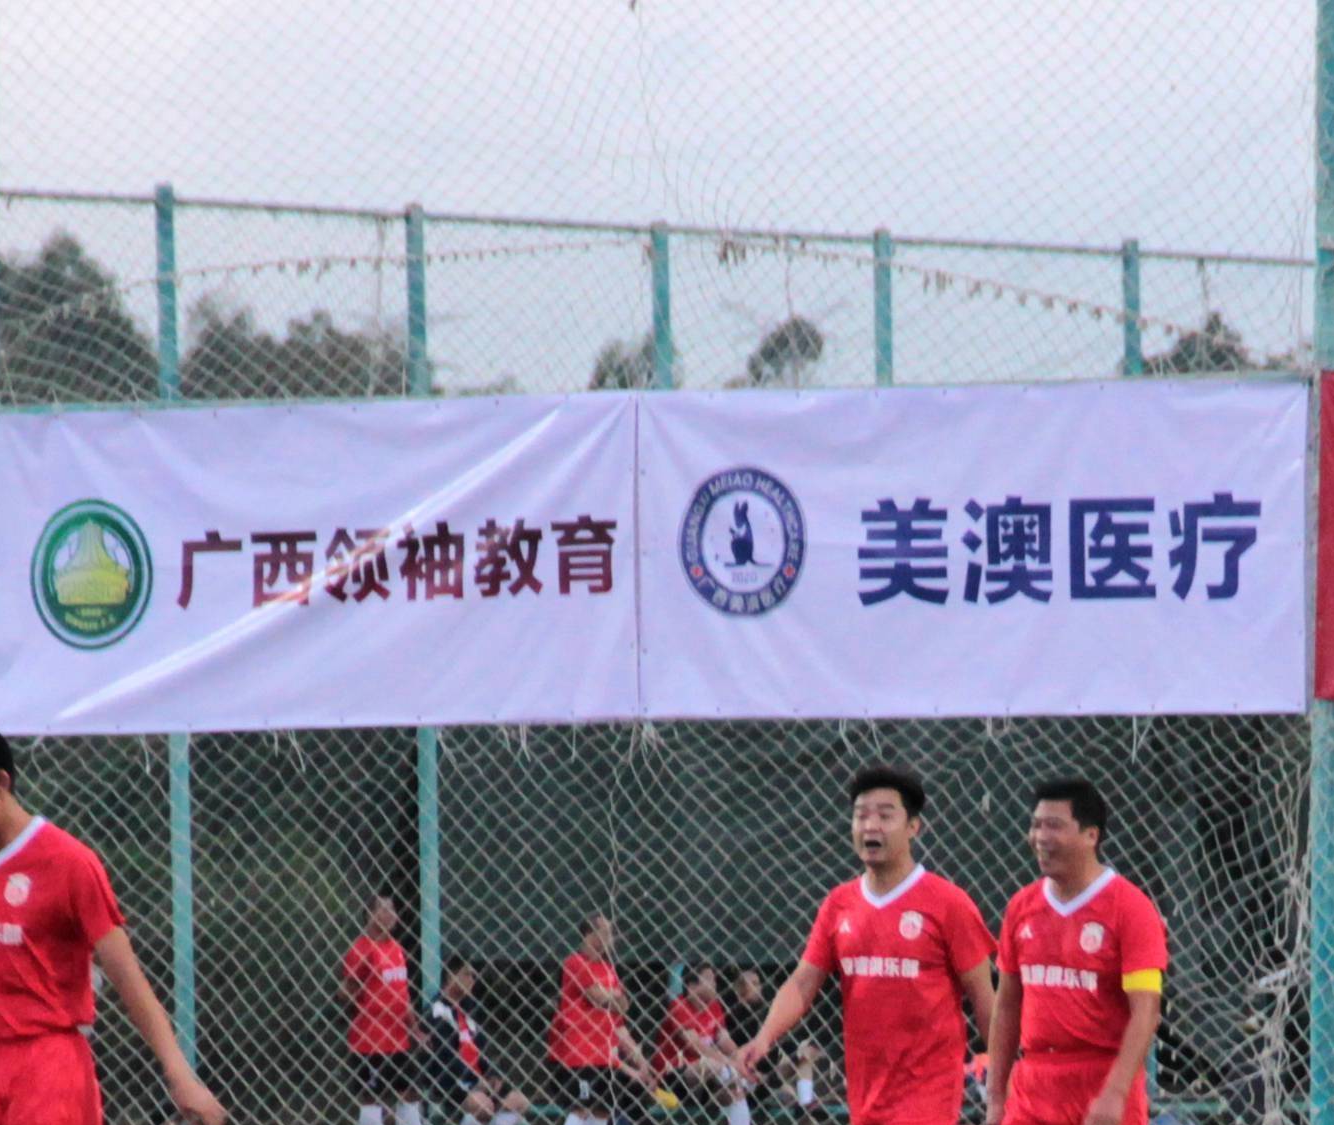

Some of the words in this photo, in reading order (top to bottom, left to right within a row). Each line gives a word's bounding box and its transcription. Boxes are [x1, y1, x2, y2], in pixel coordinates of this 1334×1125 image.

[176, 514, 618, 609] 广西领袖教育
[857, 491, 1262, 605] 美澳医疗
